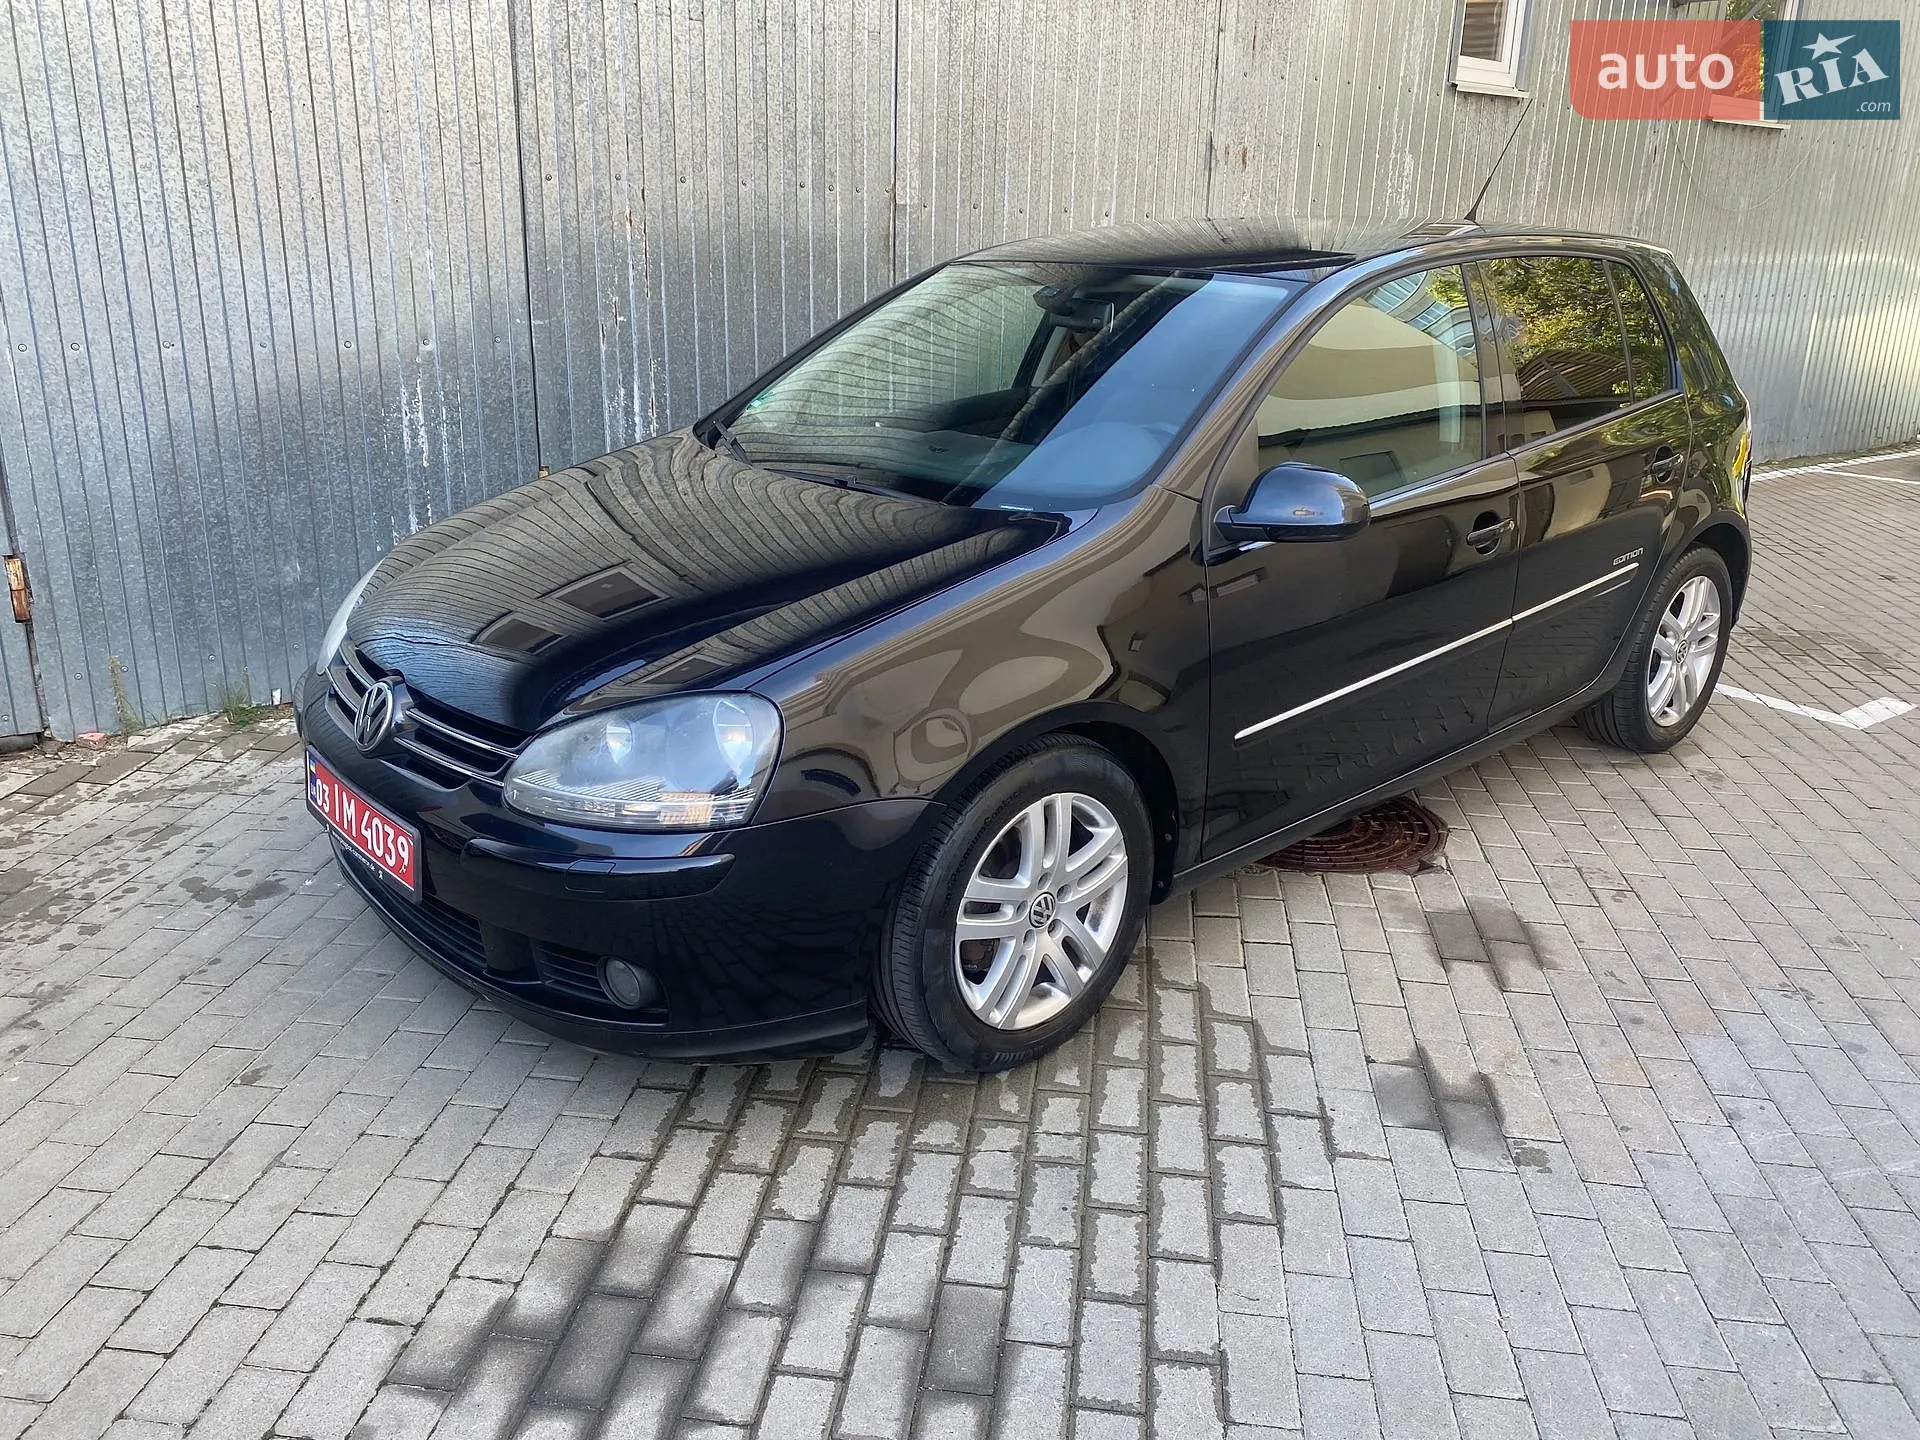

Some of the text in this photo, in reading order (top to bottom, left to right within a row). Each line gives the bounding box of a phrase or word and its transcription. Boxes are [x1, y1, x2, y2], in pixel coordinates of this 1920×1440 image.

[1612, 547, 1644, 566] EDITION
[316, 778, 330, 813] 03
[334, 783, 357, 838] IM
[361, 810, 409, 869] 4039
